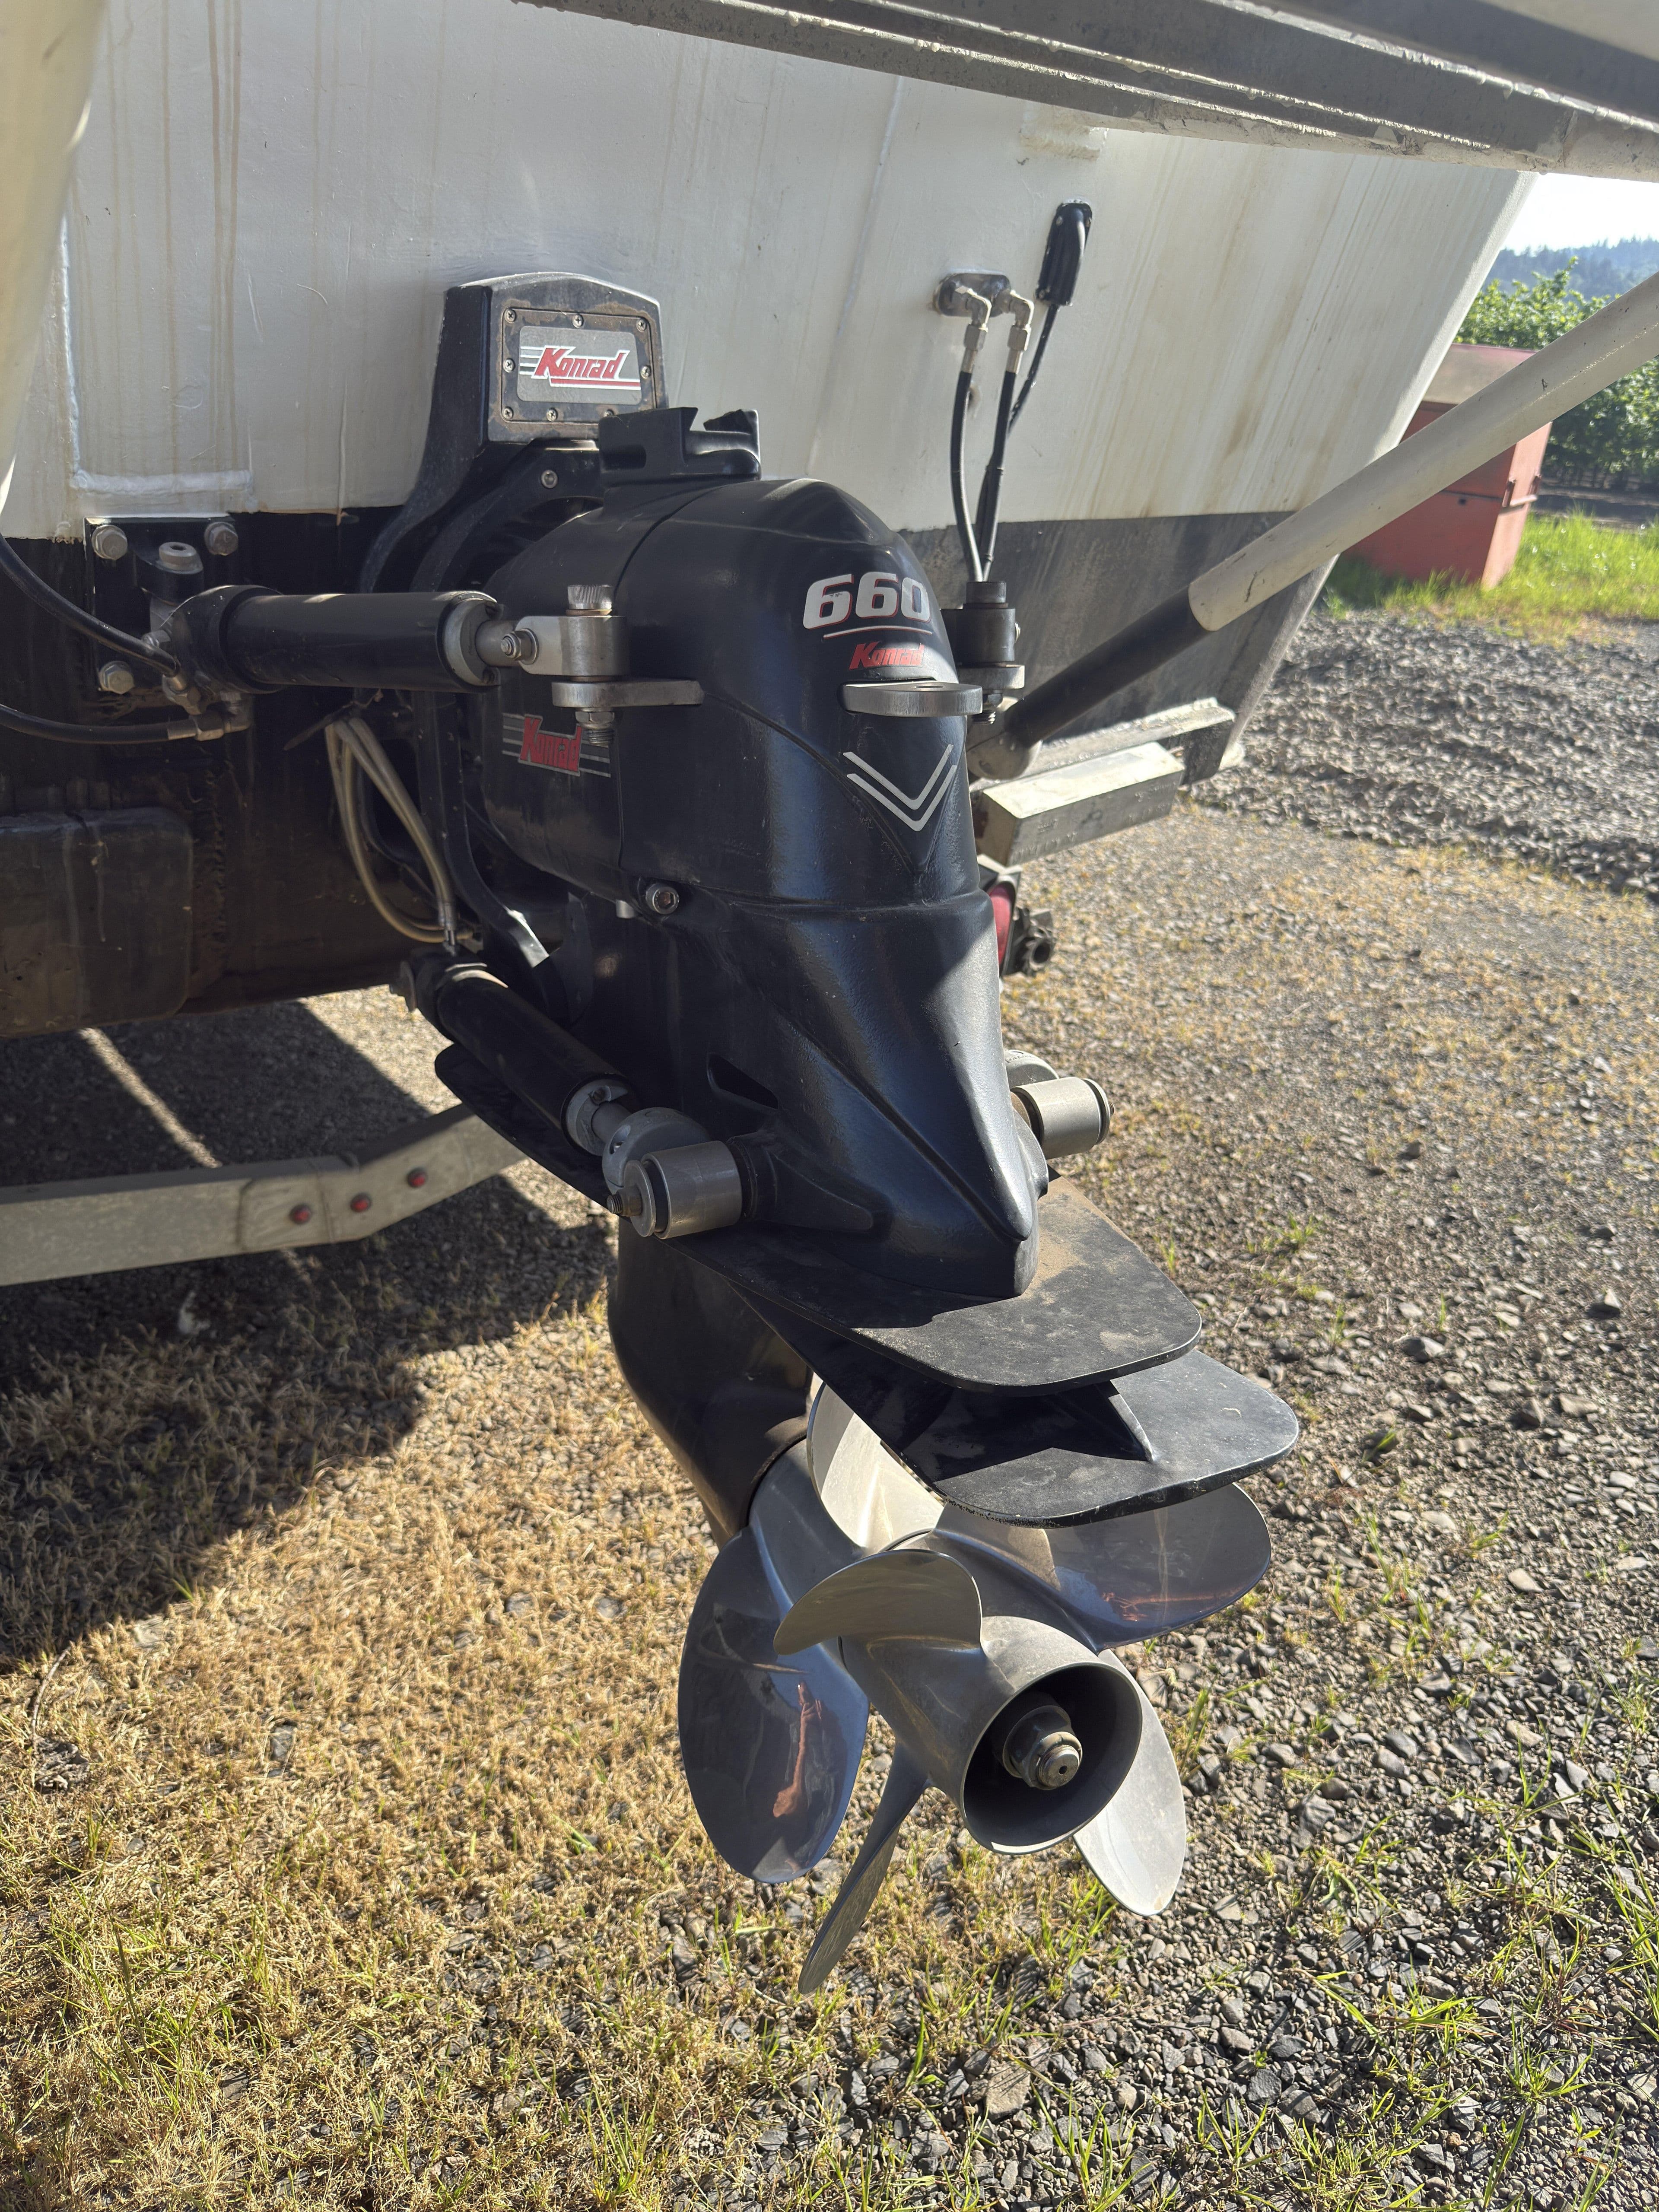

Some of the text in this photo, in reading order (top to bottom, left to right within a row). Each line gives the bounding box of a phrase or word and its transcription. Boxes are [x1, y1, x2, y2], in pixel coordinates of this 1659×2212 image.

[533, 346, 628, 379] Konrad
[803, 572, 931, 629] 660
[849, 642, 924, 670] Konrad
[519, 716, 582, 773] Konrad
